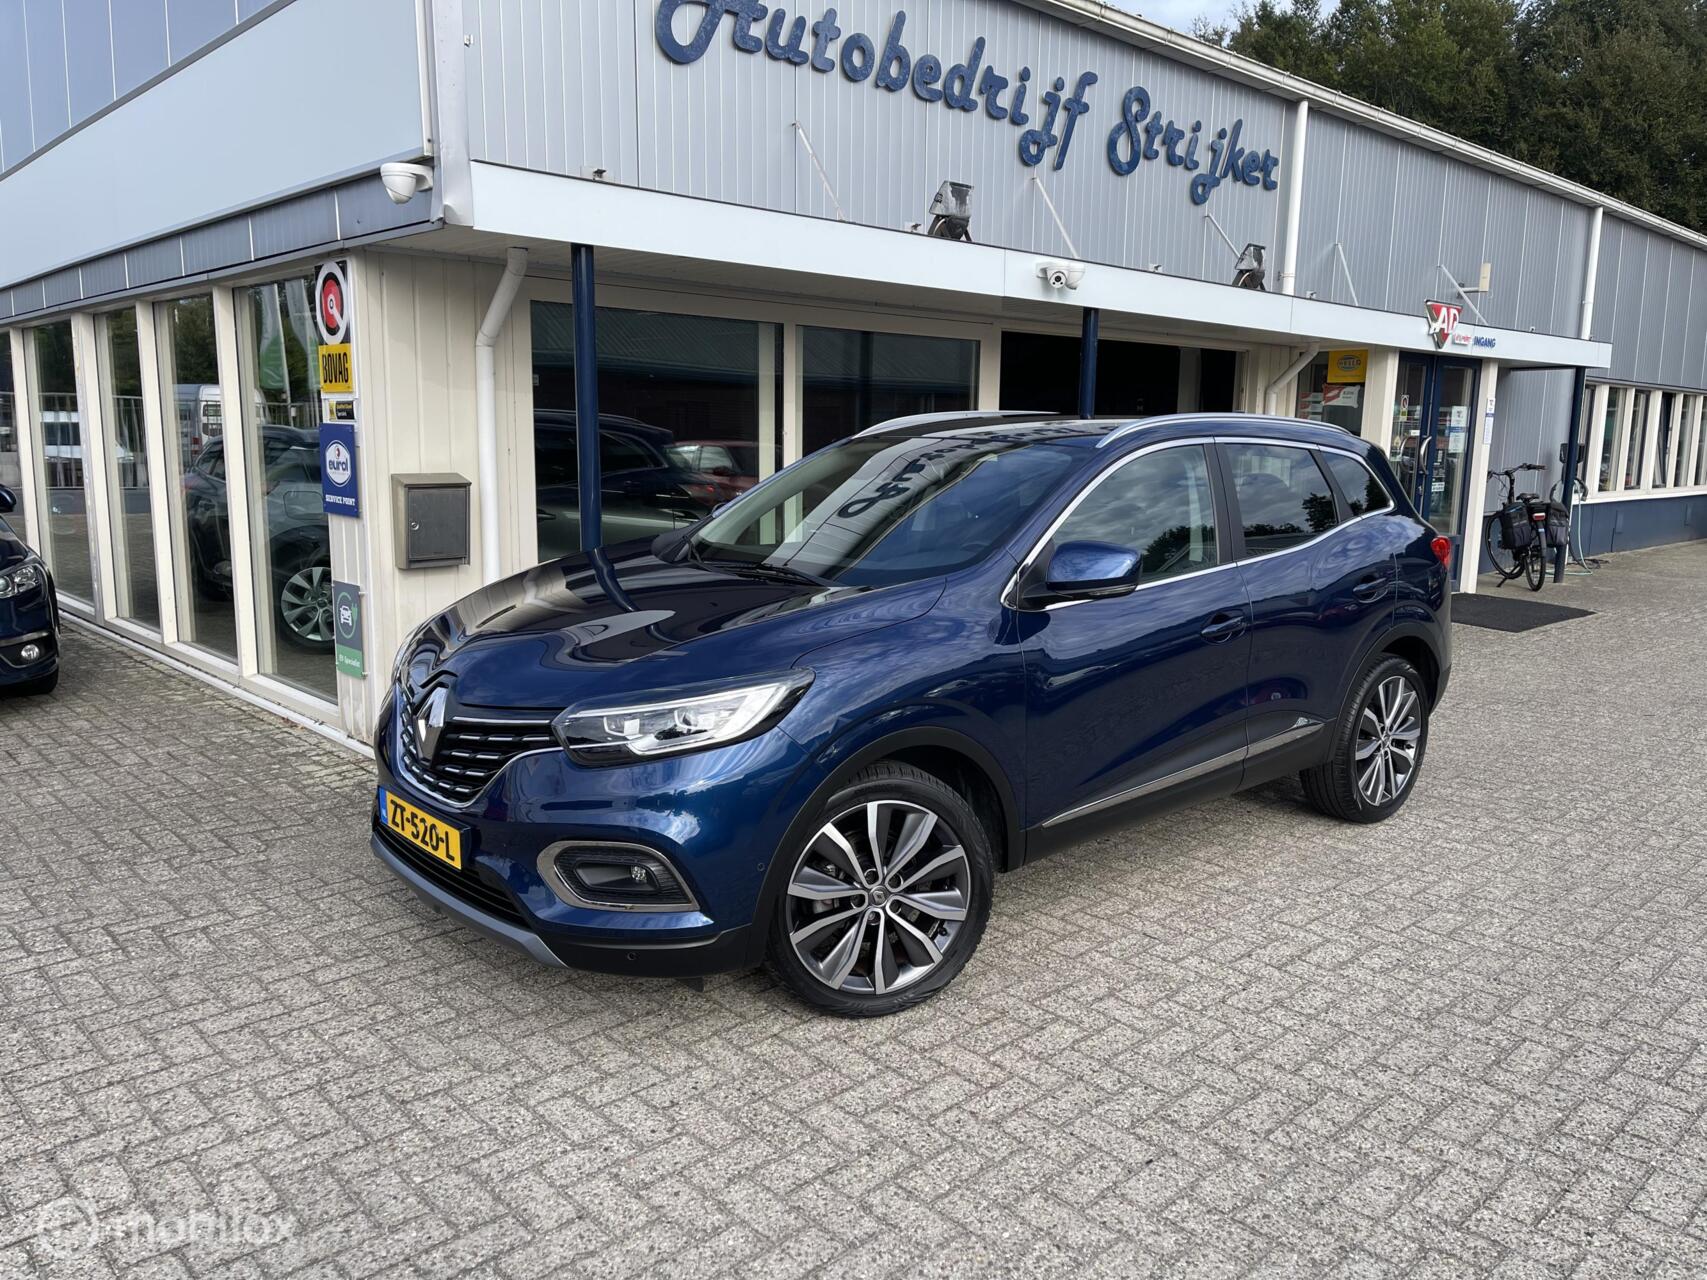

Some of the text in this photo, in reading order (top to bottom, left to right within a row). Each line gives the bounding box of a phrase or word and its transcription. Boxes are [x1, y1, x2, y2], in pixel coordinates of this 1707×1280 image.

[1107, 86, 1279, 205] Strijker
[1429, 306, 1459, 334] AD
[1474, 336, 1496, 348] INGANG
[322, 352, 348, 384] BOVAG
[329, 458, 348, 472] eurol
[390, 799, 455, 861] ZT-520-L
